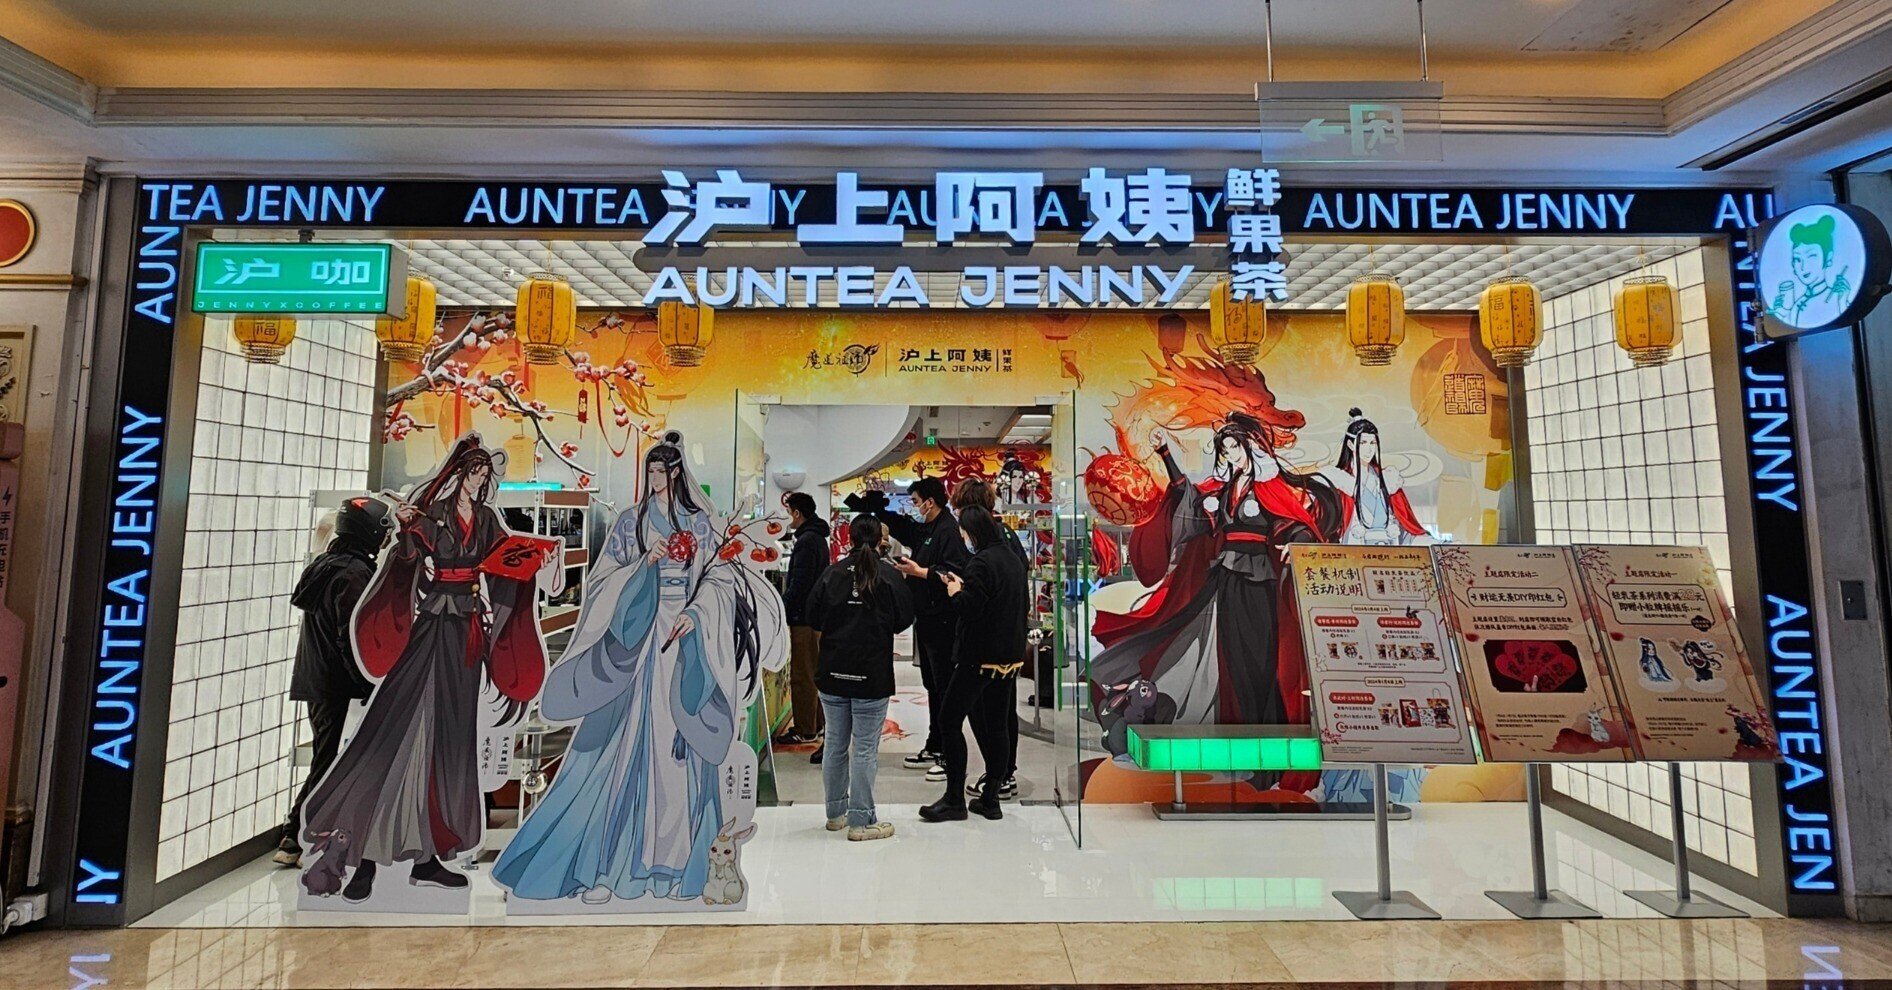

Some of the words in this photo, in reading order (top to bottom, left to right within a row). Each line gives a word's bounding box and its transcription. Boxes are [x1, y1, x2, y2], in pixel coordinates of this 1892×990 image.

[143, 185, 223, 220] TEA
[237, 186, 385, 222] JENNY
[465, 188, 649, 224] AUNTEA
[643, 167, 1194, 245] 沪上阿姨
[1304, 194, 1483, 229] AUNTEA
[1497, 194, 1635, 229] JENNY
[1225, 168, 1290, 301] 鲜果茶
[135, 226, 179, 323] AUN
[214, 257, 370, 286] 沪咖
[643, 265, 930, 308] AUNTEA
[960, 265, 1194, 307] JENNY
[898, 348, 992, 362] 沪上阿姨
[898, 365, 947, 373] AUNTEA
[952, 365, 991, 373] JENNY
[1747, 366, 1798, 511] JENNY
[112, 405, 161, 555] JENNY
[1304, 566, 1360, 581] 套餐机制
[1305, 583, 1364, 597] 活动说明
[91, 569, 147, 769] AUNTEA
[1767, 594, 1824, 790] AUNTEA
[1786, 806, 1836, 890] JEN
[76, 859, 119, 904] Y
